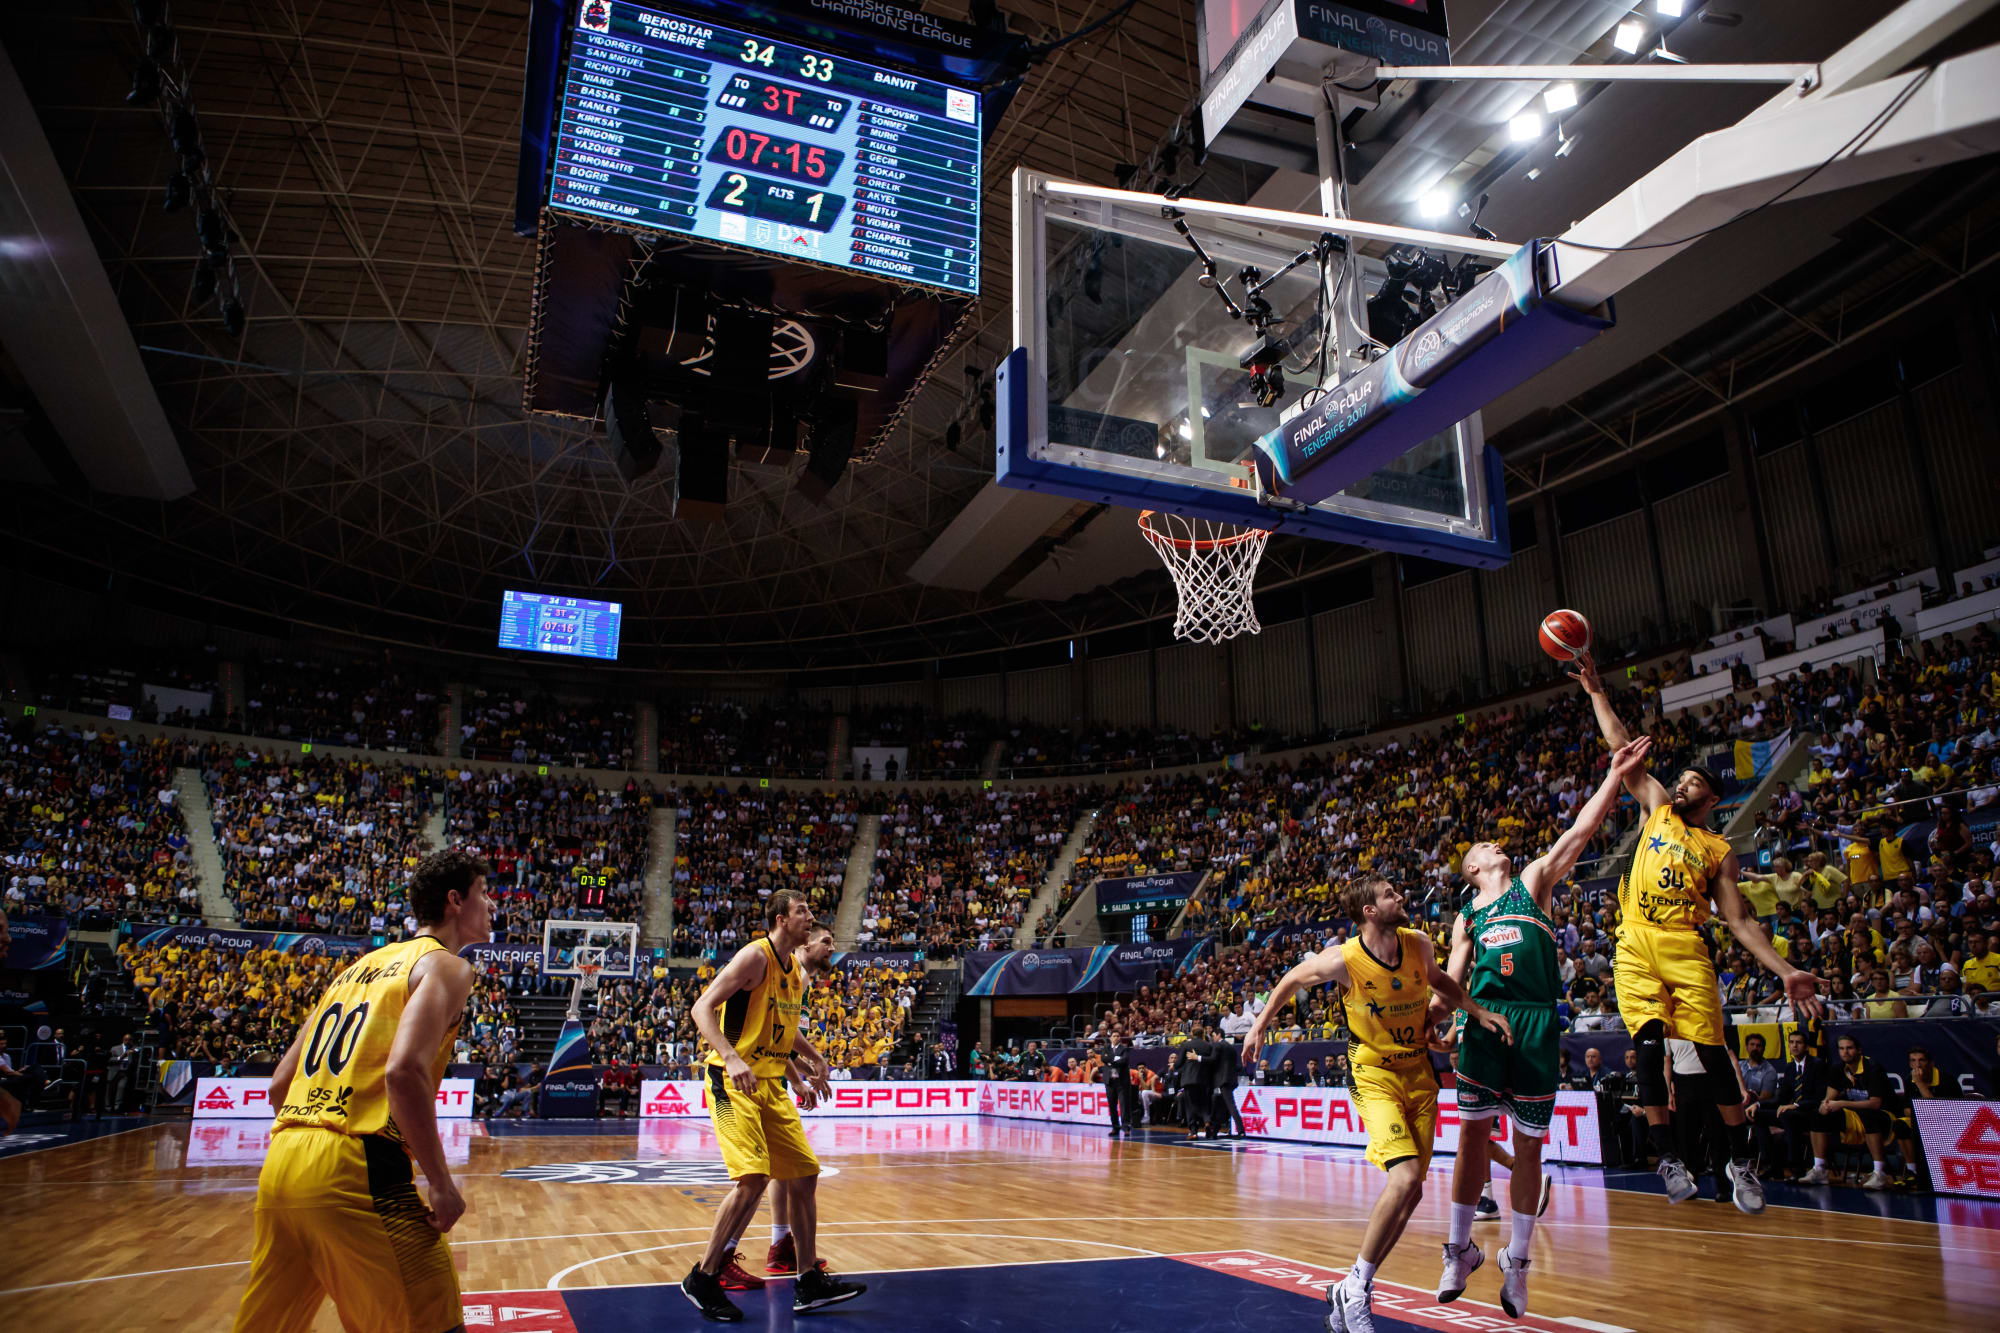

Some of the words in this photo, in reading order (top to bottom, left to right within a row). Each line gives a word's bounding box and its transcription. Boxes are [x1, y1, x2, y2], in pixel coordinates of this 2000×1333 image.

[811, 0, 908, 31] CHAMPIONS
[912, 22, 972, 48] LEAGUE
[1309, 4, 1366, 34] FINAL
[1389, 28, 1439, 56] FOUR
[588, 35, 644, 55] VIDORRETA
[644, 25, 707, 49] TENERIFE
[638, 12, 713, 39] IBEROSTAR
[740, 39, 775, 68] 34
[800, 54, 835, 82] 33
[872, 72, 918, 92] BANVIT
[584, 61, 631, 78] RICHOTTI
[586, 48, 607, 60] SAN
[608, 53, 645, 68] MIGUEL
[700, 74, 708, 84] 9
[1208, 73, 1241, 117] FINAL
[1253, 12, 1286, 61] FOUR
[582, 74, 615, 88] NIANG
[580, 86, 623, 103] BASSAS
[696, 113, 704, 122] 3
[734, 77, 750, 90] TO
[763, 85, 801, 116] 3T
[827, 100, 843, 112] TO
[578, 100, 621, 116] HANLEY
[871, 104, 919, 122] FILIPOVSKI
[576, 112, 623, 129] KIRKSAY
[693, 139, 701, 148] 4
[871, 116, 908, 132] SONMEZ
[575, 126, 625, 144] GRIGONIS
[870, 128, 899, 142] MURIC
[571, 153, 635, 174] ABROMAITIS
[574, 139, 622, 157] VAZQUEZ
[691, 166, 699, 175] 4
[725, 129, 826, 179] 07:15
[869, 141, 897, 153] KULIG
[970, 165, 977, 174] 5
[569, 166, 610, 183] BOGRIS
[868, 166, 906, 180] GOKALP
[869, 153, 898, 167] GECIM
[970, 178, 977, 186] 3
[868, 178, 901, 192] ORELIK
[566, 194, 640, 216] DOORNEKAMP
[568, 180, 601, 195] WHITE
[687, 206, 695, 215] 6
[723, 173, 748, 207] 2
[768, 186, 795, 200] FLTS
[806, 191, 824, 223] 1
[867, 191, 897, 205] AKYEL
[866, 204, 899, 218] MUTLU
[866, 217, 901, 232] VIDMAR
[865, 230, 912, 248] CHAPPELL
[864, 244, 911, 261] KORKMAZ
[968, 266, 976, 276] 2
[864, 256, 915, 275] THEODORE
[1293, 416, 1327, 447] FINAL
[1340, 380, 1372, 414] FOUR
[1302, 419, 1346, 459] TENERIFE
[1347, 402, 1367, 427] 2017
[548, 597, 560, 605] 34
[566, 599, 577, 607] 33
[544, 633, 552, 642] 2
[567, 635, 573, 645] 1
[580, 875, 607, 887] 07:15
[1127, 881, 1148, 889] FINAL
[1154, 878, 1174, 887] FOUR
[1657, 866, 1686, 891] 34
[1111, 903, 1131, 912] SALIDA
[8, 926, 49, 936] HAMPIONS
[175, 934, 208, 948] FINAL
[221, 937, 252, 949] FOUR
[473, 949, 543, 963] TENERIFE
[1120, 950, 1144, 960] FINAL
[1152, 947, 1174, 958] FOUR
[1500, 952, 1514, 977] 5
[332, 966, 358, 990] AN
[304, 1001, 370, 1078] 00
[772, 1023, 785, 1045] 17
[1388, 1025, 1416, 1046] 42
[545, 1082, 567, 1091] FINAL
[574, 1082, 595, 1091] FOUR
[198, 1100, 236, 1110] PEAK
[646, 1102, 692, 1115] PEAK
[835, 1087, 976, 1109] SPORT
[997, 1088, 1046, 1112] PEAK
[1051, 1090, 1121, 1117] SPOR
[1275, 1098, 1365, 1133] PEA
[1939, 1155, 2000, 1191] PE
